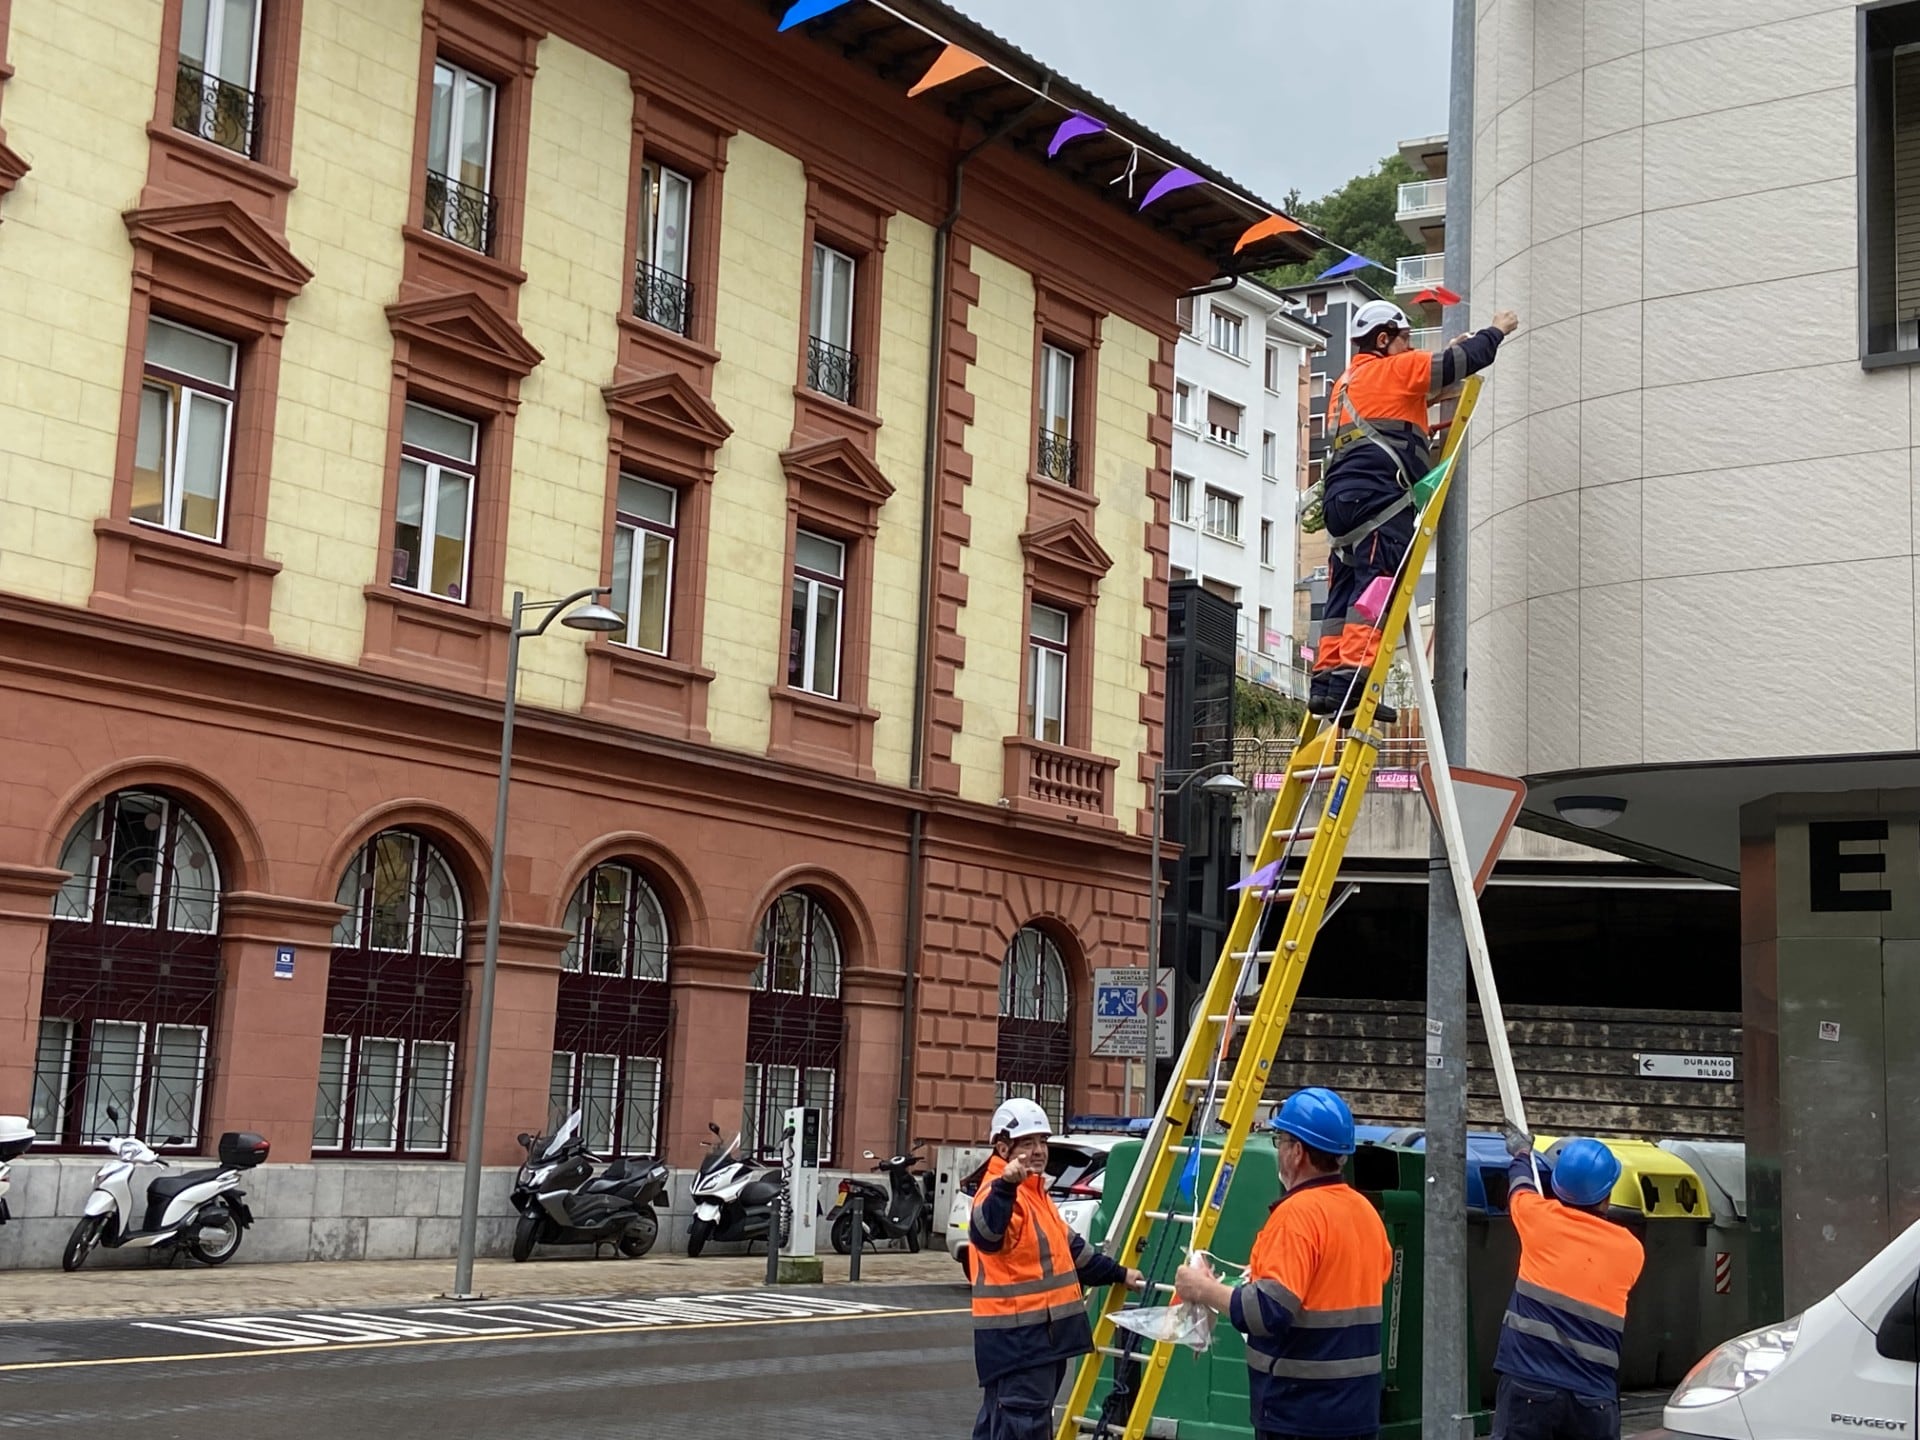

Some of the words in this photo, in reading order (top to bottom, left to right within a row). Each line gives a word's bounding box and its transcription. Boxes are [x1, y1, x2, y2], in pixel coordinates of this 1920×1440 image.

[1809, 820, 1892, 912] E
[1683, 1058, 1732, 1067] DURANGO
[1697, 1069, 1732, 1077] BILBAO
[1388, 1252, 1402, 1367] ecovidrio
[1830, 1412, 1908, 1432] PEUGEOT
